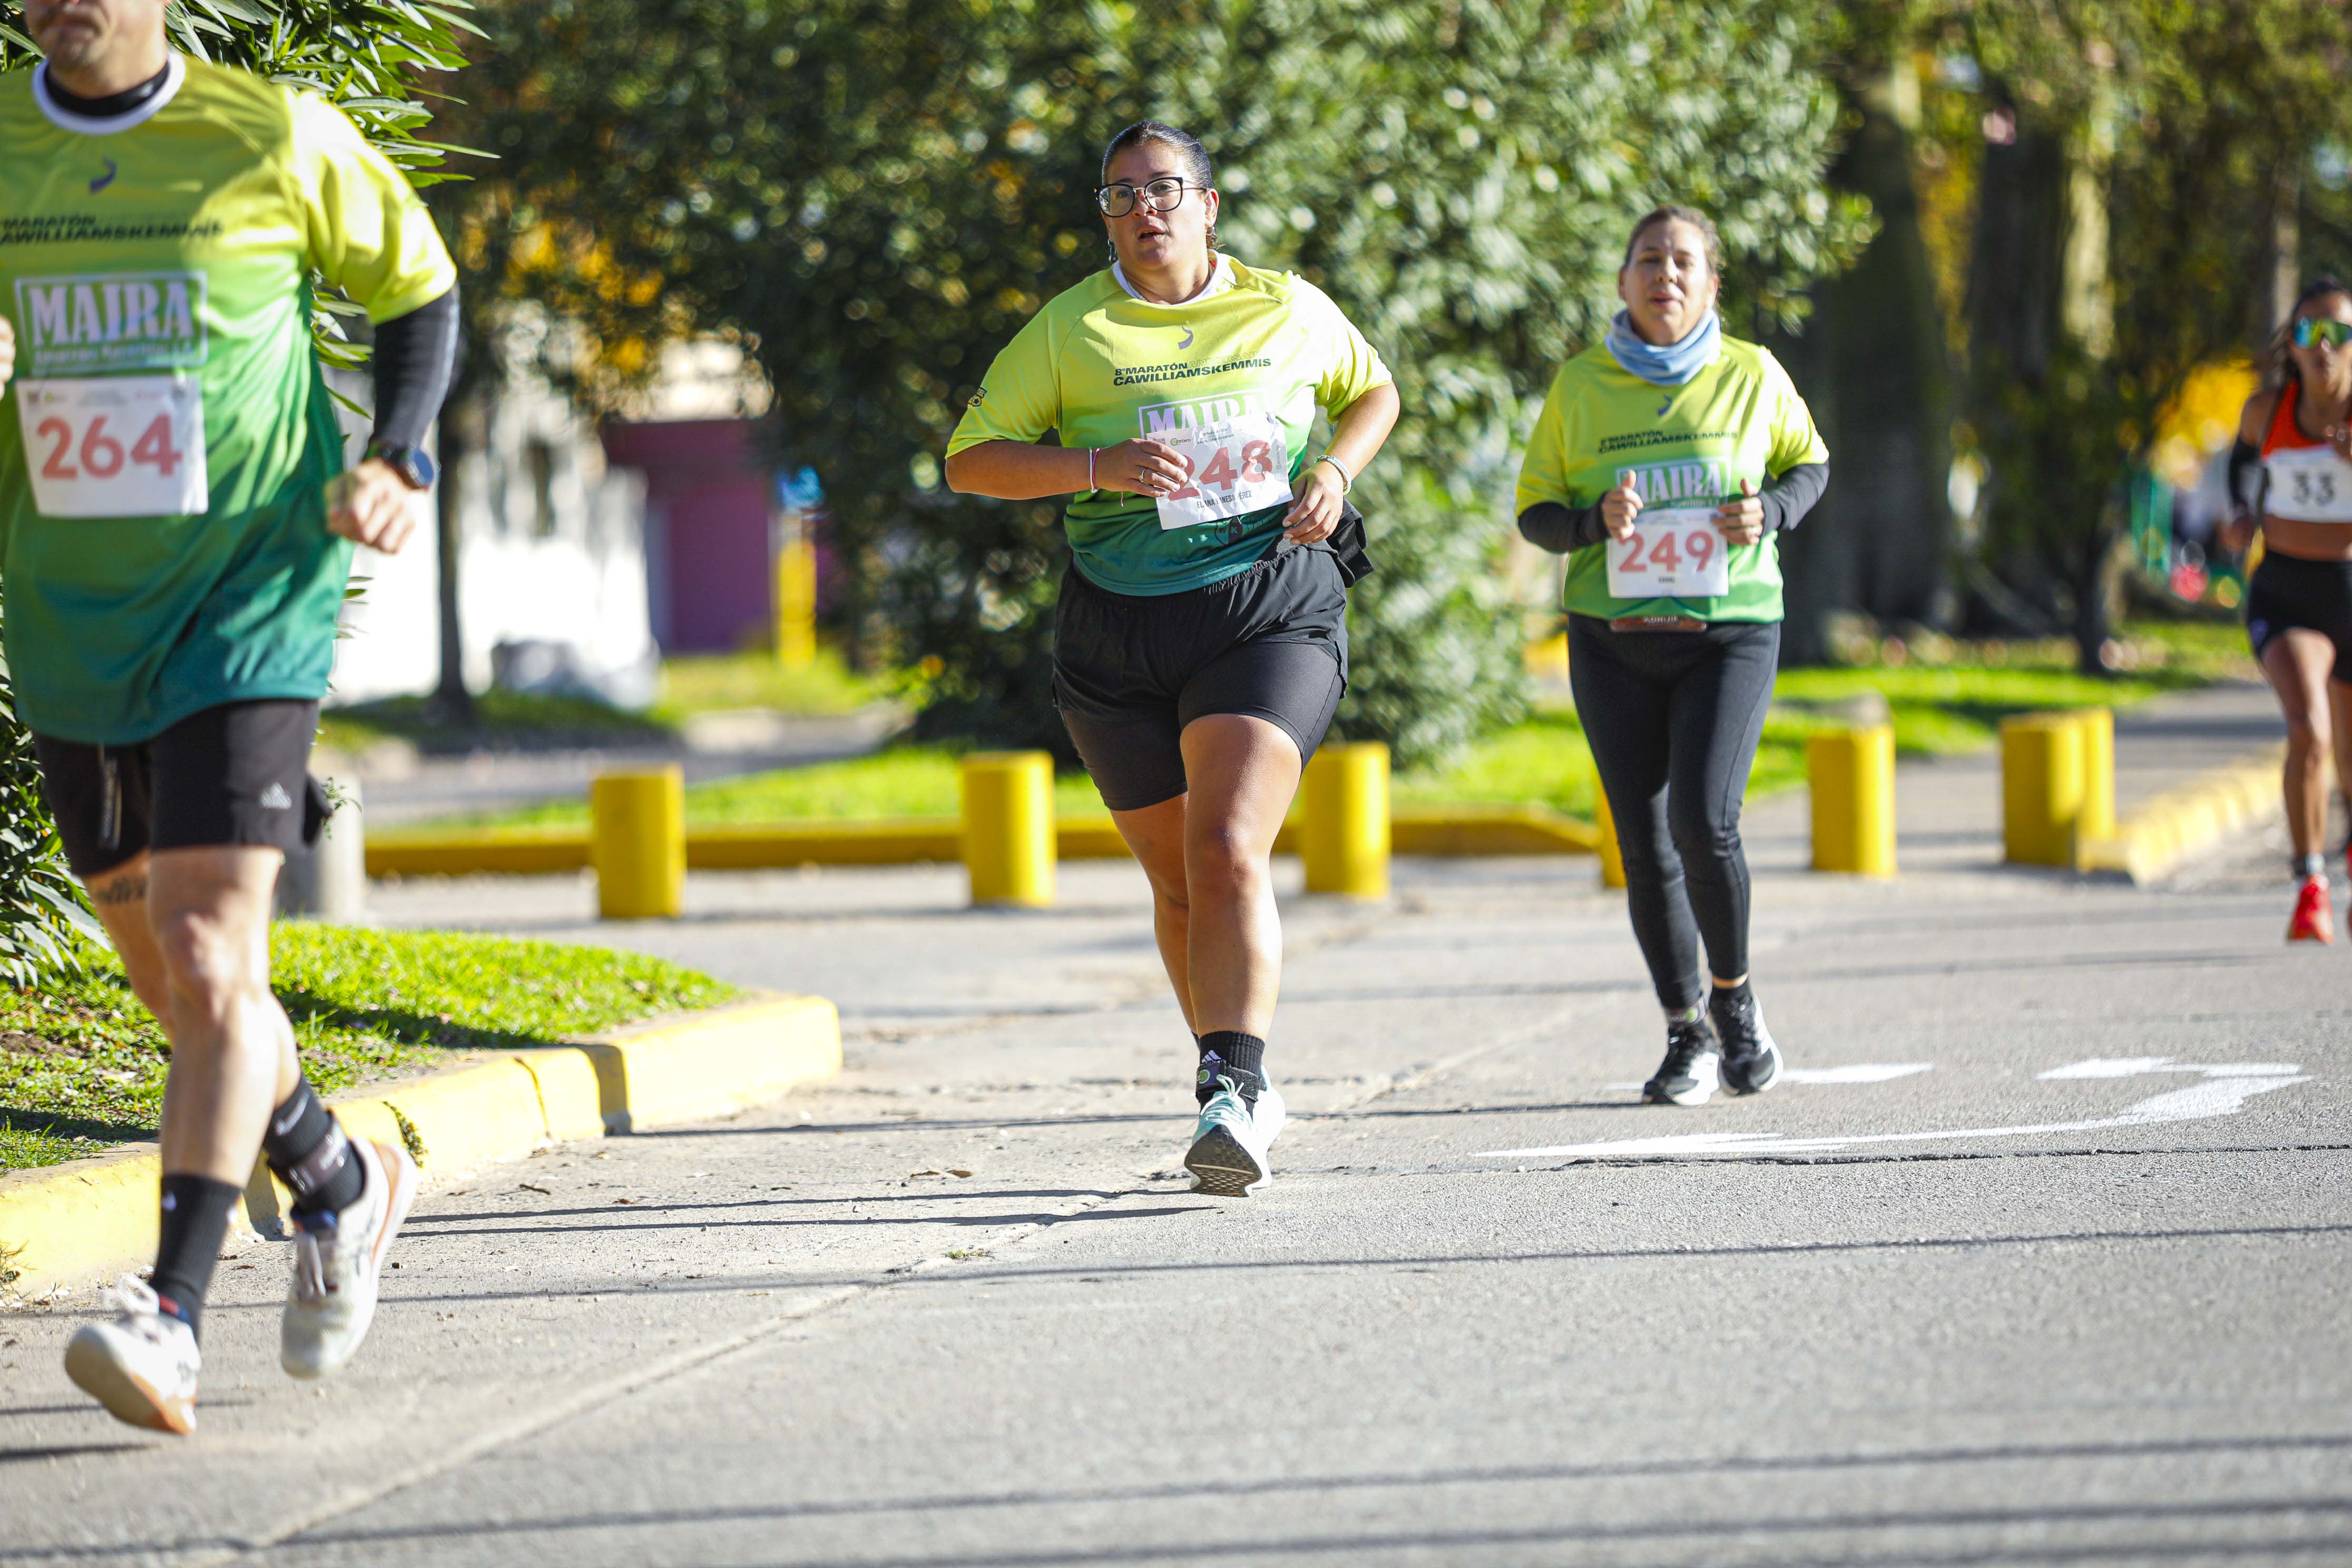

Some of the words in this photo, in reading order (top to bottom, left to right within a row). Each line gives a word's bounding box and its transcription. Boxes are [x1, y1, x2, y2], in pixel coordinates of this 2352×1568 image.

[28, 281, 194, 347] MAIRA
[1113, 358, 1271, 386] CAWILLIAMSKEMMIS
[37, 412, 183, 479] 264
[1168, 439, 1272, 501] 248
[2292, 471, 2335, 507] 33
[1197, 498, 1215, 508] ELANA
[1238, 490, 1252, 499] ÉREZ
[1618, 530, 1715, 573] 249
